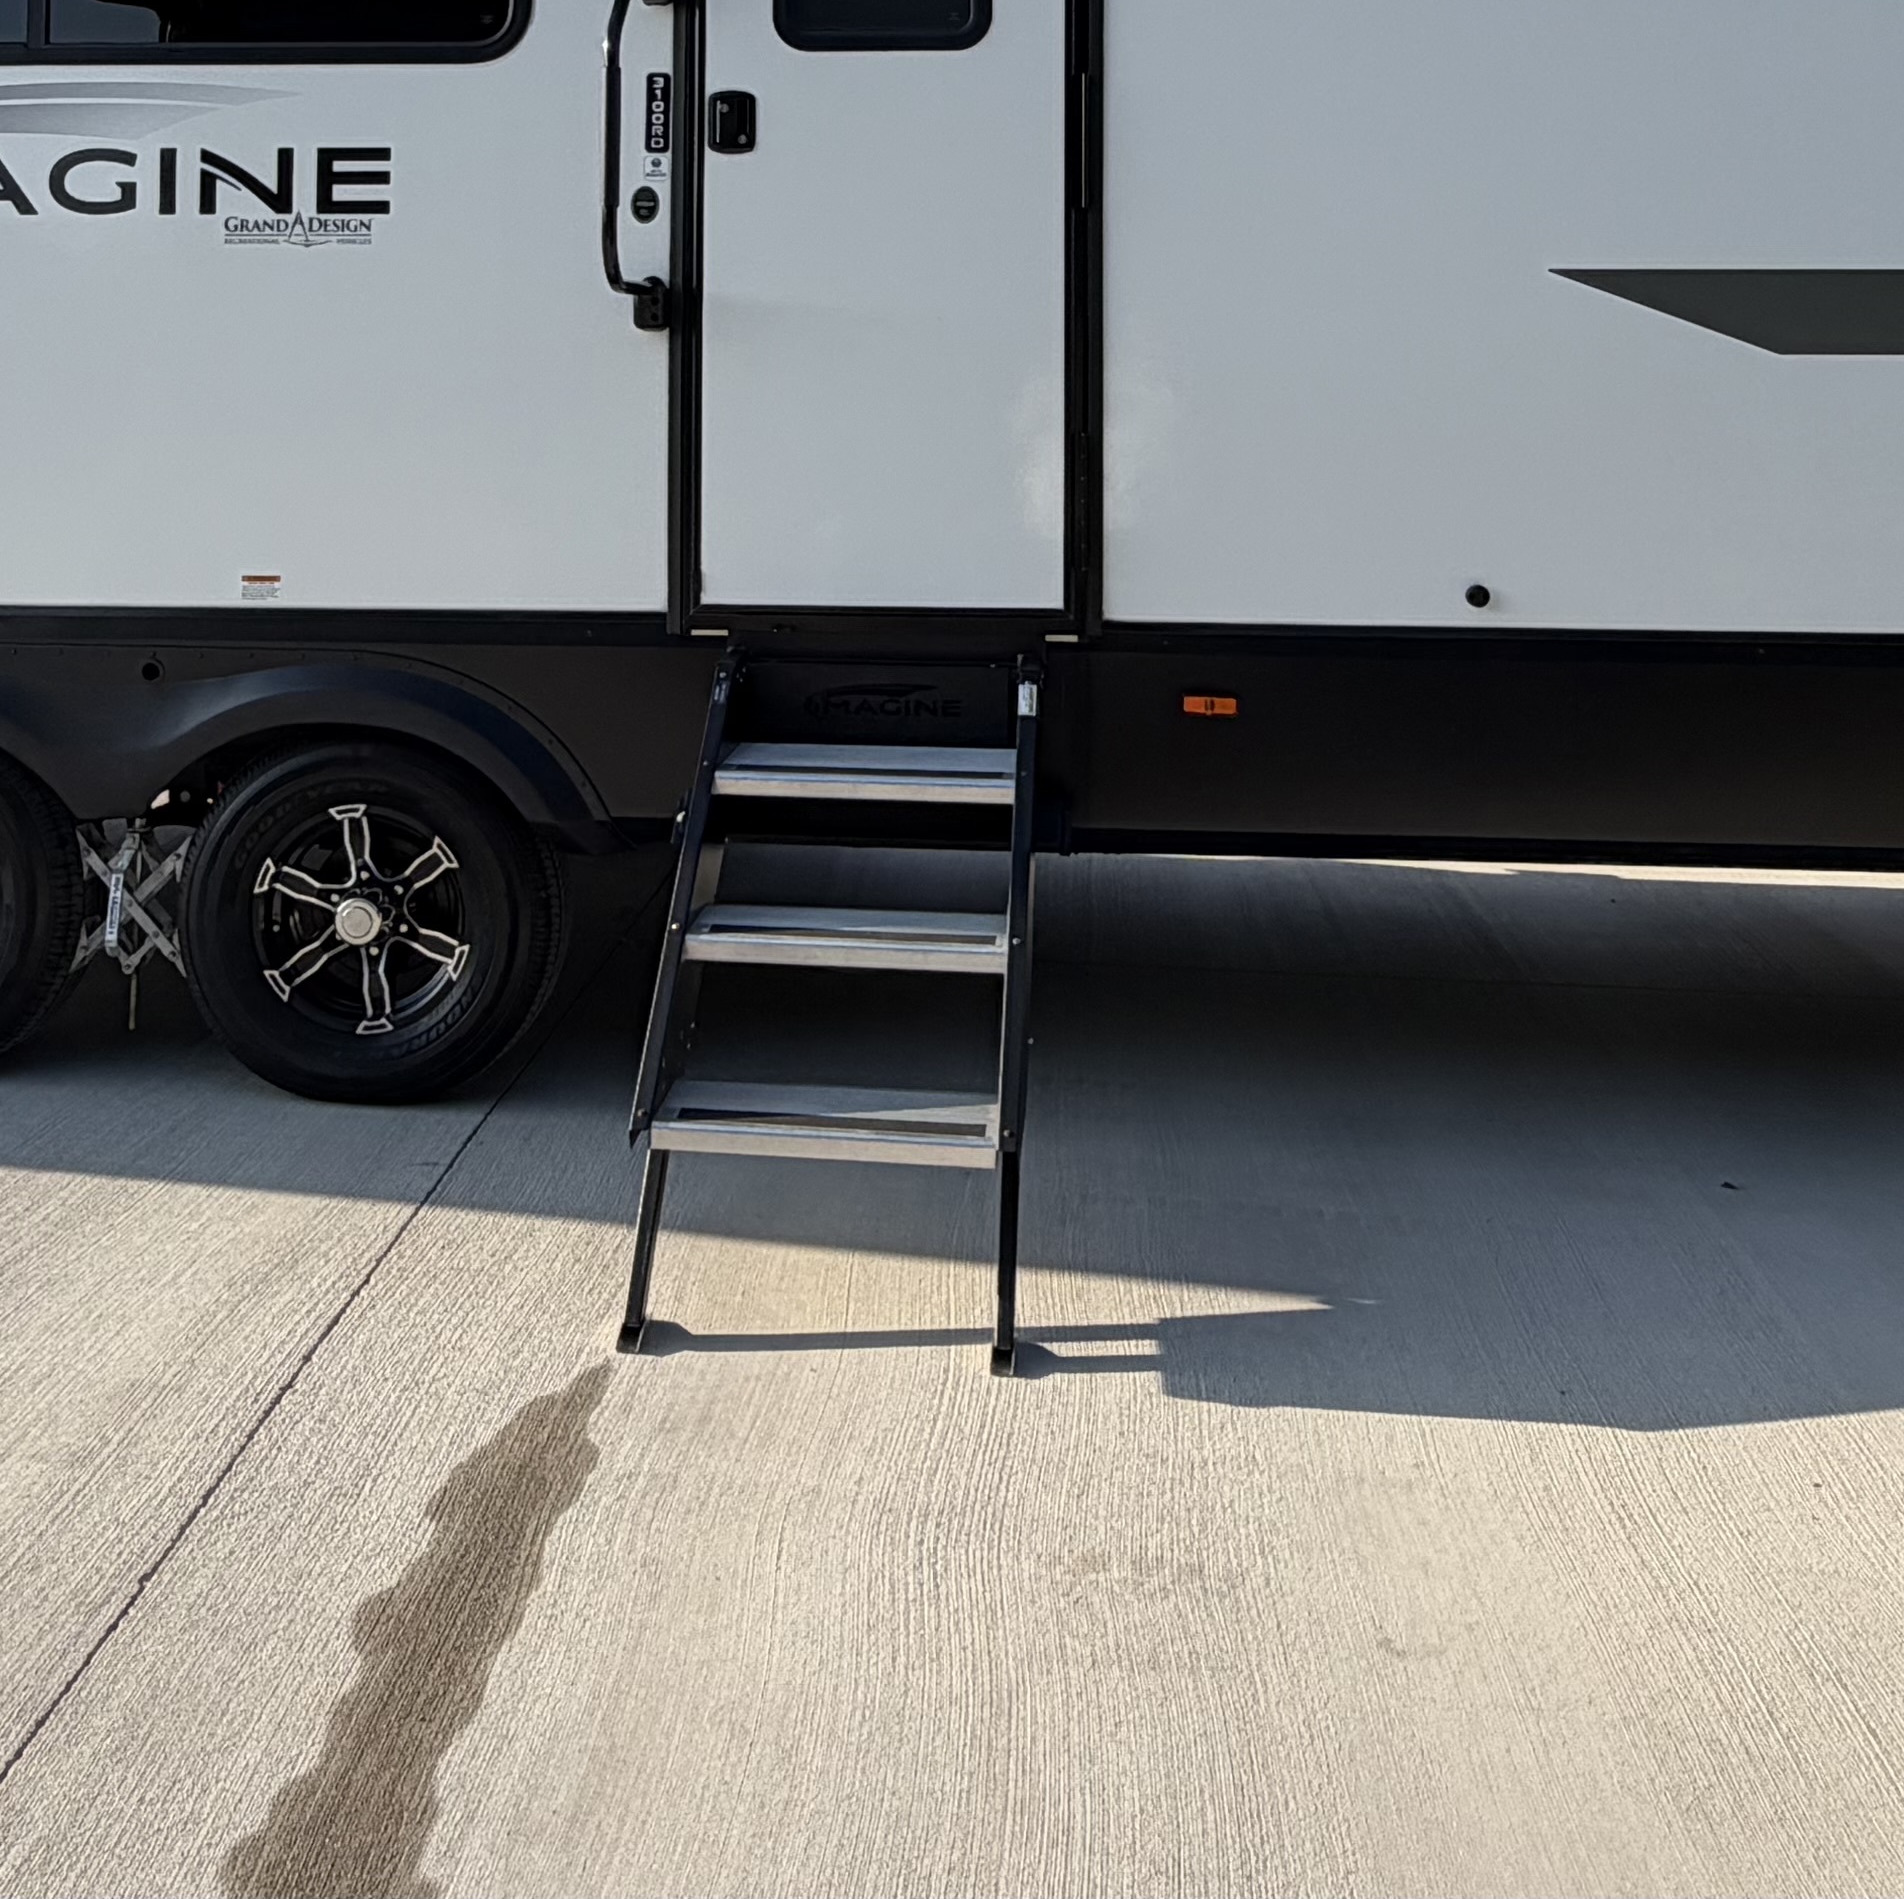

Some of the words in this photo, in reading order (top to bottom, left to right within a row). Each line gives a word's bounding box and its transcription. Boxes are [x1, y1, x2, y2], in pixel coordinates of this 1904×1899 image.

[650, 76, 665, 148] 3100RD
[223, 216, 289, 233] GRAND
[307, 216, 373, 233] DESIGN
[813, 698, 962, 718] IMAGINE
